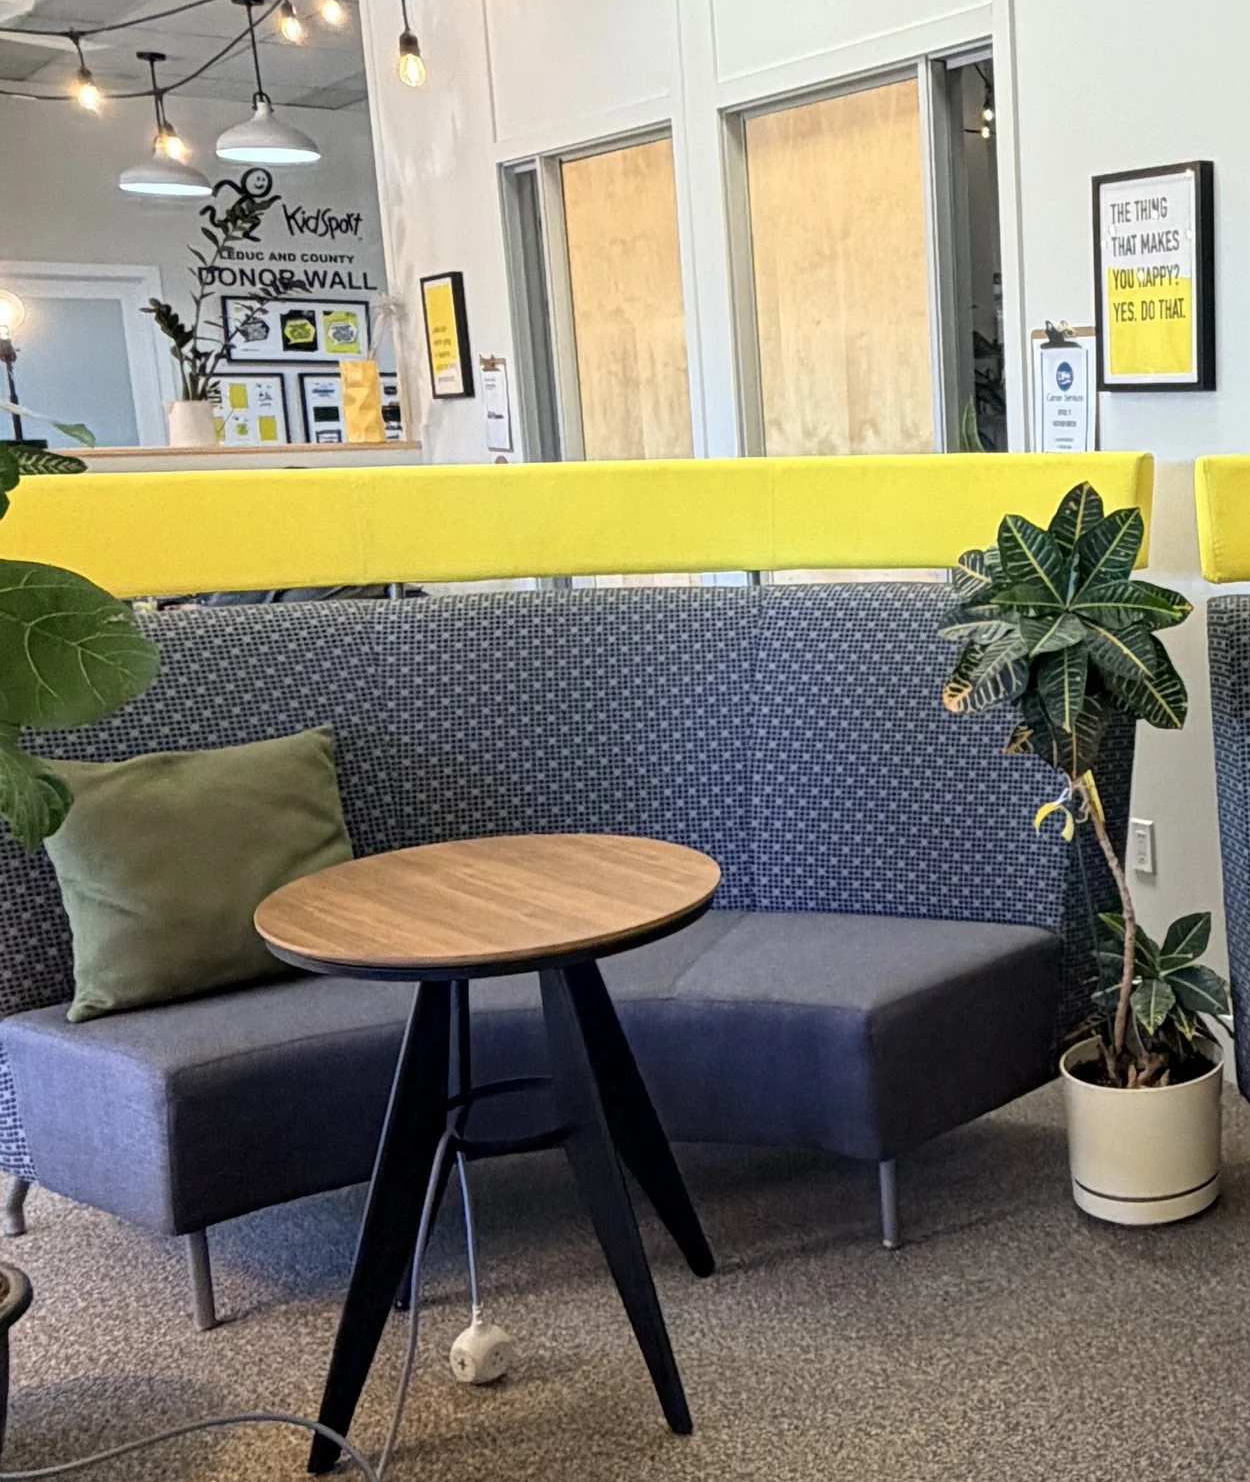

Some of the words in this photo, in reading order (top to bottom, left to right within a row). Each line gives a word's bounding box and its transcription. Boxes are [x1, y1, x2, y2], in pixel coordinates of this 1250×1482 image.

[281, 204, 363, 240] KidSport
[1110, 202, 1131, 224] THE
[1134, 197, 1168, 221] THING
[1111, 234, 1137, 257] THAT
[1140, 230, 1180, 255] MAKES
[219, 250, 264, 262] LEDUC
[269, 252, 297, 262] AND
[301, 253, 355, 264] COUNTY
[304, 269, 378, 291] WALL
[1112, 268, 1135, 290] YOU
[1141, 300, 1155, 321] DO
[1158, 298, 1186, 320] THAT.
